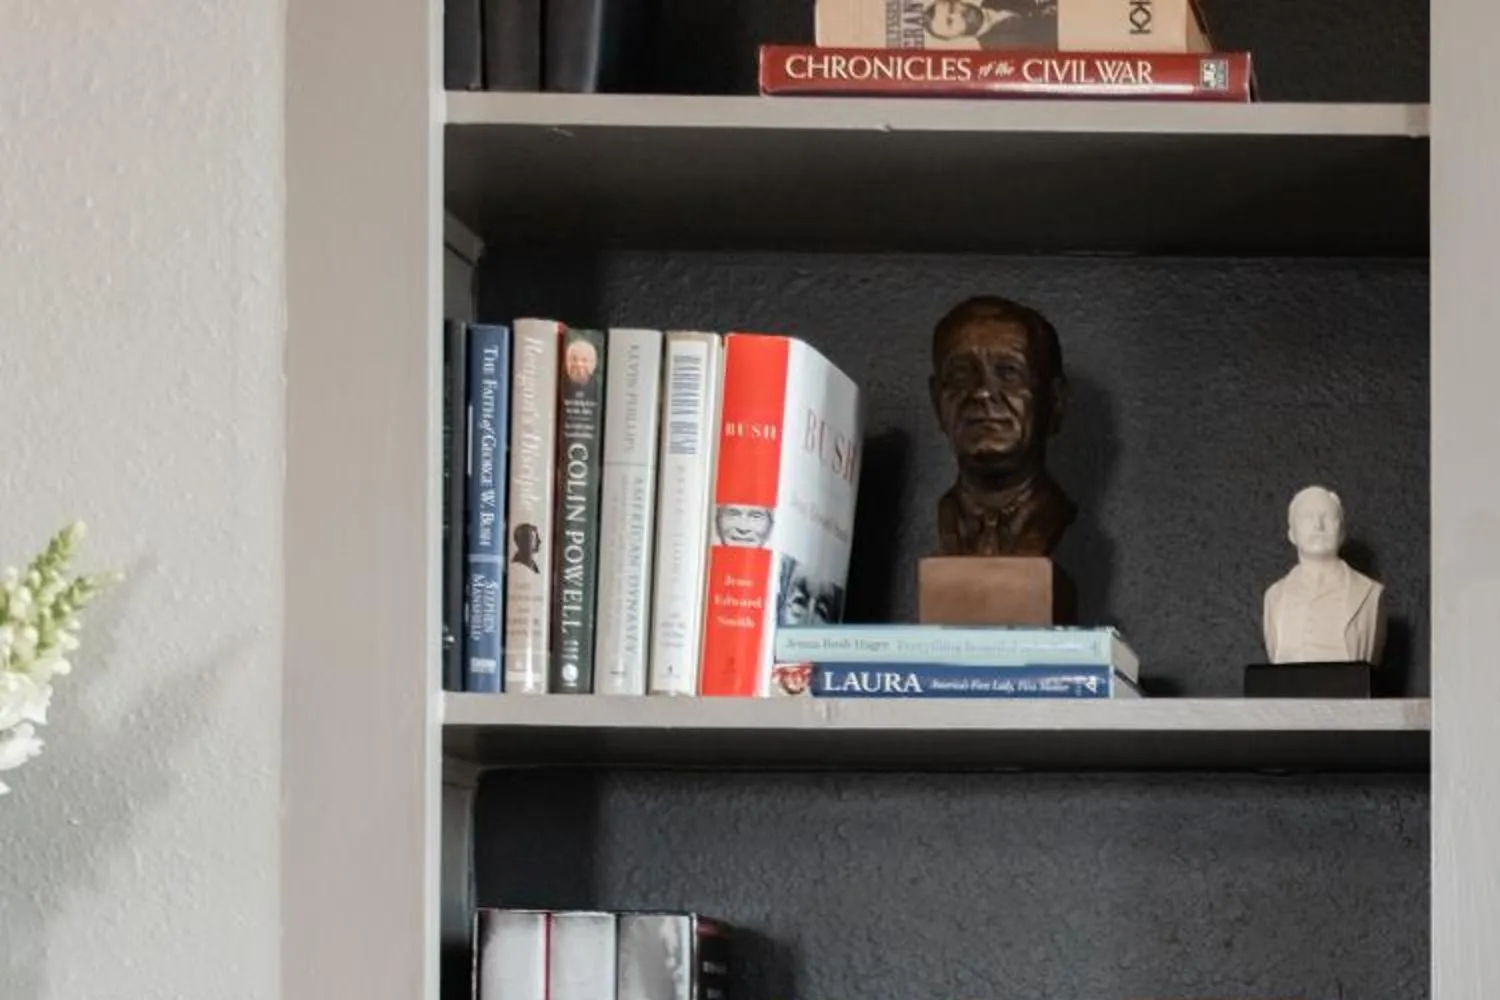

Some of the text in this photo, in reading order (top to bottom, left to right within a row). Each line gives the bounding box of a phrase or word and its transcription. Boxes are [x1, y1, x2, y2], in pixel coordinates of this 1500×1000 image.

[785, 54, 1153, 84] CHRONICLES of the CIVIL WAR
[516, 334, 546, 512] Reagan's Disciple
[623, 344, 641, 454] KEVIN PHILLIPS
[669, 354, 702, 456] BARBARA BUSH
[724, 421, 777, 440] BUSH
[479, 345, 499, 547] THE FAITH of GEORGE W. BUSH
[566, 442, 589, 523] COLIN
[804, 409, 860, 486] BUSH
[561, 529, 586, 635] POWELL
[625, 476, 646, 656] AMERICAN DYNASTY
[471, 573, 484, 641] MANSFIELD
[484, 580, 498, 633] STEPHEN
[821, 639, 851, 650] Bush
[823, 671, 923, 693] LAURA
